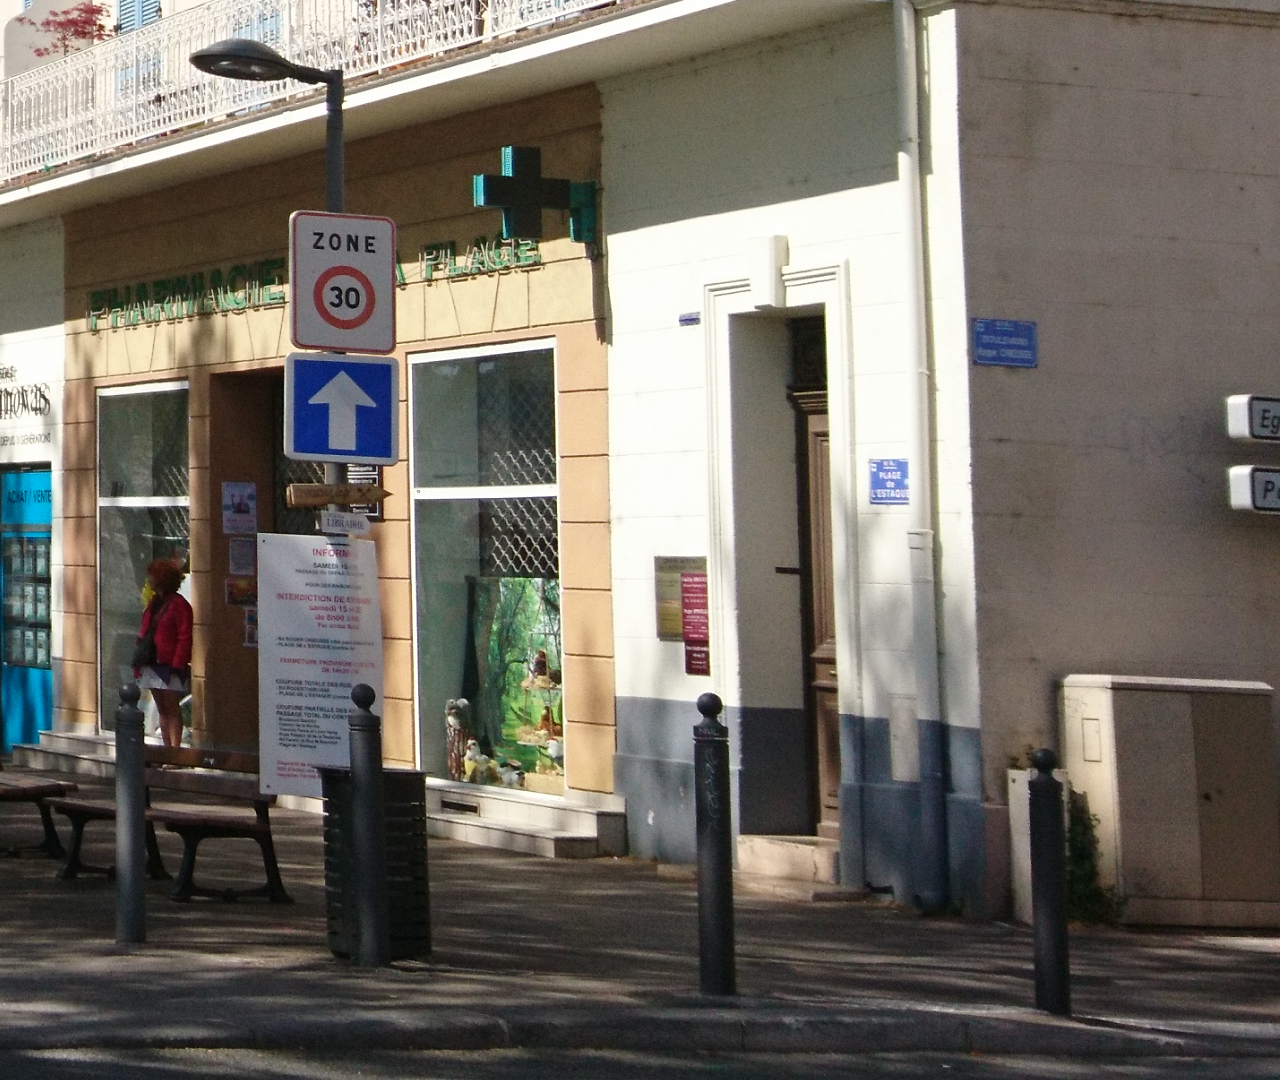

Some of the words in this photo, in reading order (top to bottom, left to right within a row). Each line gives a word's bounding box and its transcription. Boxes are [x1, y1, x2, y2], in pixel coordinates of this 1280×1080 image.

[312, 231, 377, 255] ZONE
[418, 236, 542, 281] PLAGE
[86, 256, 286, 333] PHARMACIE
[328, 285, 361, 310] 30
[879, 471, 901, 480] PLAGE
[6, 490, 27, 504] ACHAT
[33, 488, 52, 503] VENTE
[276, 593, 332, 602] INTERDICTION
